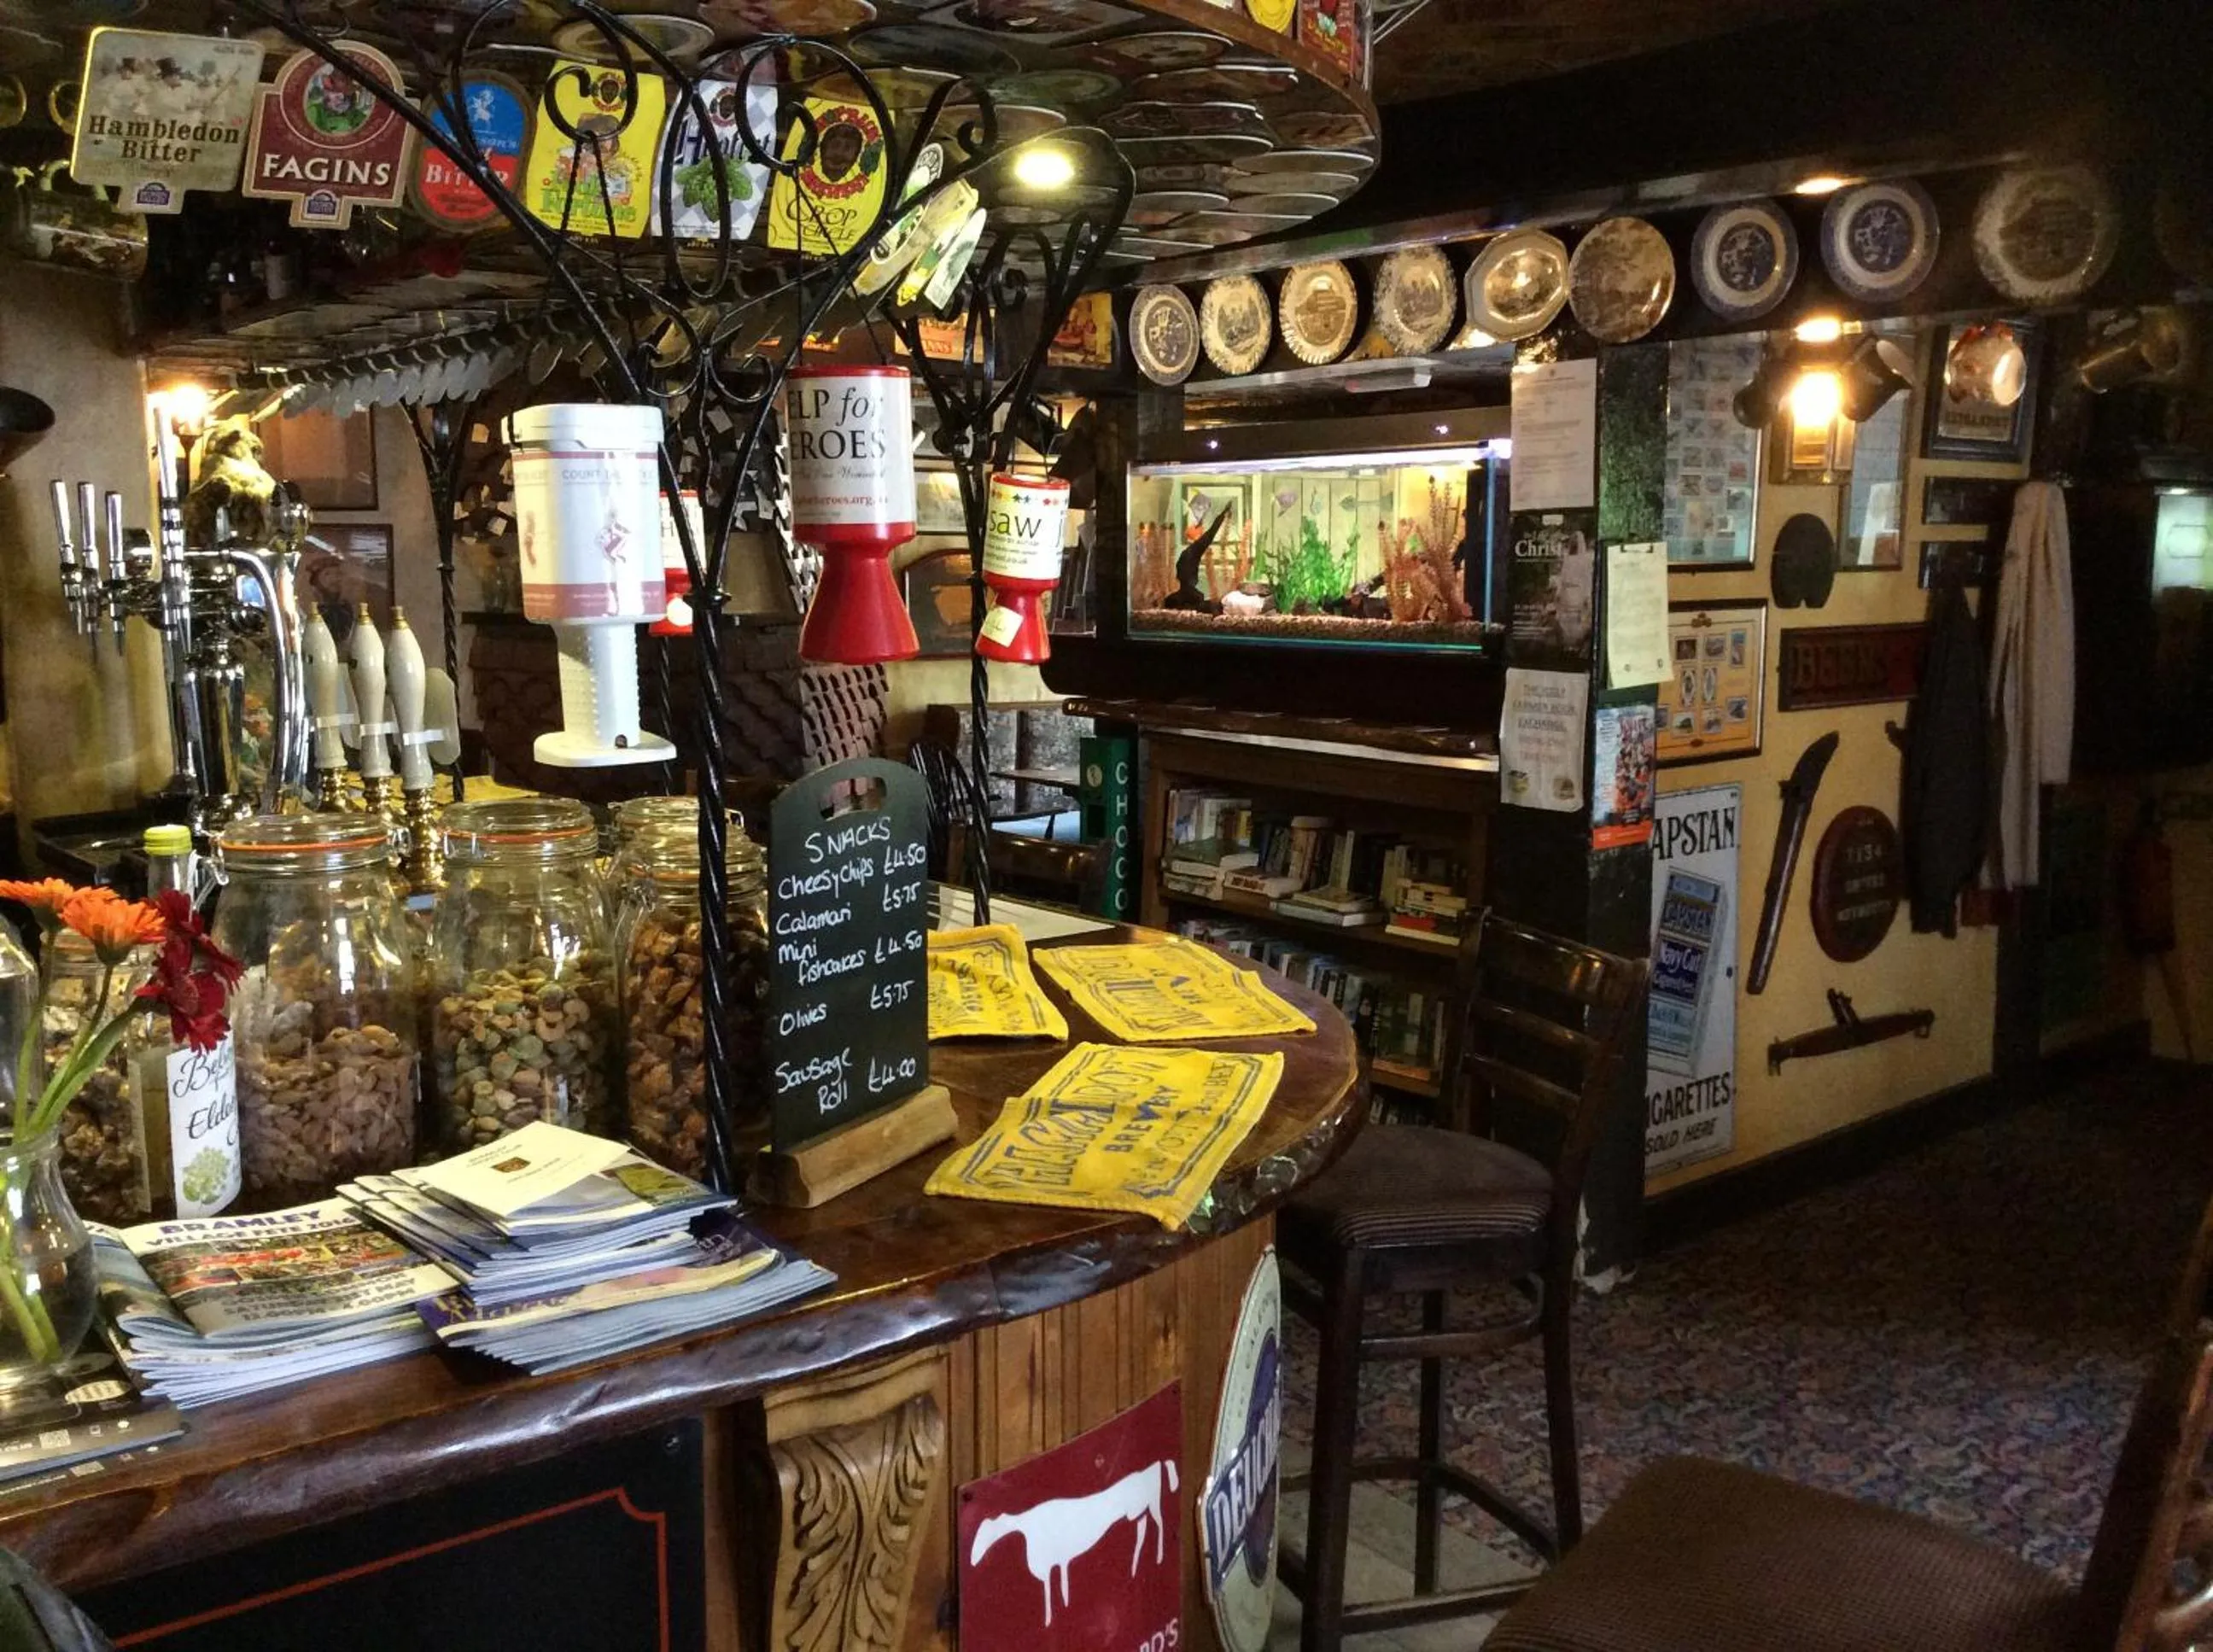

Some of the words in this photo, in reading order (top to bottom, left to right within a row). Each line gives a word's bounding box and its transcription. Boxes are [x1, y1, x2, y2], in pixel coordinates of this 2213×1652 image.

[89, 114, 240, 144] Hambledon
[121, 139, 201, 163] Bitter
[261, 152, 392, 187] FAGINS
[425, 163, 510, 187] BITR
[785, 198, 858, 226] CROP
[787, 388, 831, 419] ELP
[789, 429, 885, 460] EROES
[804, 816, 891, 863] SNACKS
[1653, 807, 1736, 860] APSTAN
[775, 902, 852, 936] Calamari
[780, 1001, 827, 1036] Olives
[774, 1046, 853, 1095] Sausage
[816, 1078, 850, 1115] Roll
[1645, 1071, 1731, 1128] IGARETTES
[159, 1210, 321, 1235] BRAMLEY
